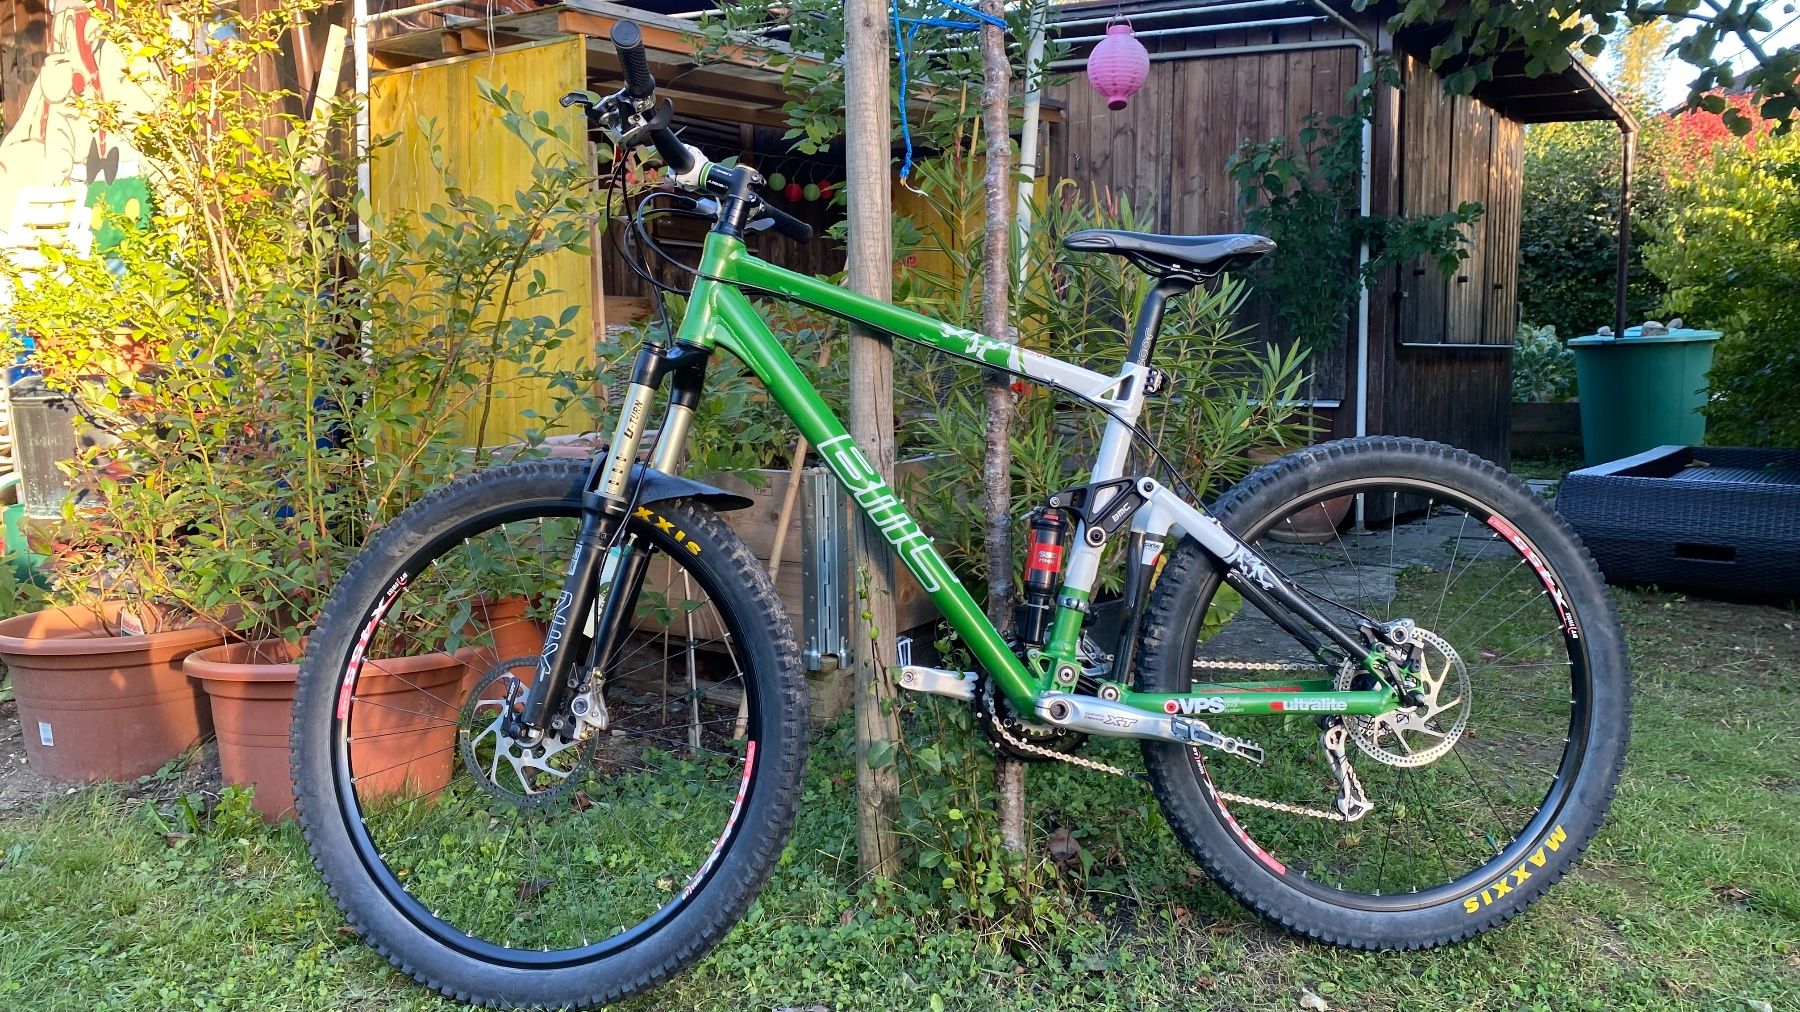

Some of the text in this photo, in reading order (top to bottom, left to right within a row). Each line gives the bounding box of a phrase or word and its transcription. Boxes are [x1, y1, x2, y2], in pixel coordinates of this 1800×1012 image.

[1112, 502, 1130, 522] BMC
[633, 506, 701, 555] XXIS
[1178, 696, 1225, 714] VPS
[1283, 698, 1348, 711] ultralite
[1103, 714, 1138, 727] XT
[1463, 824, 1567, 914] MAXXIS
